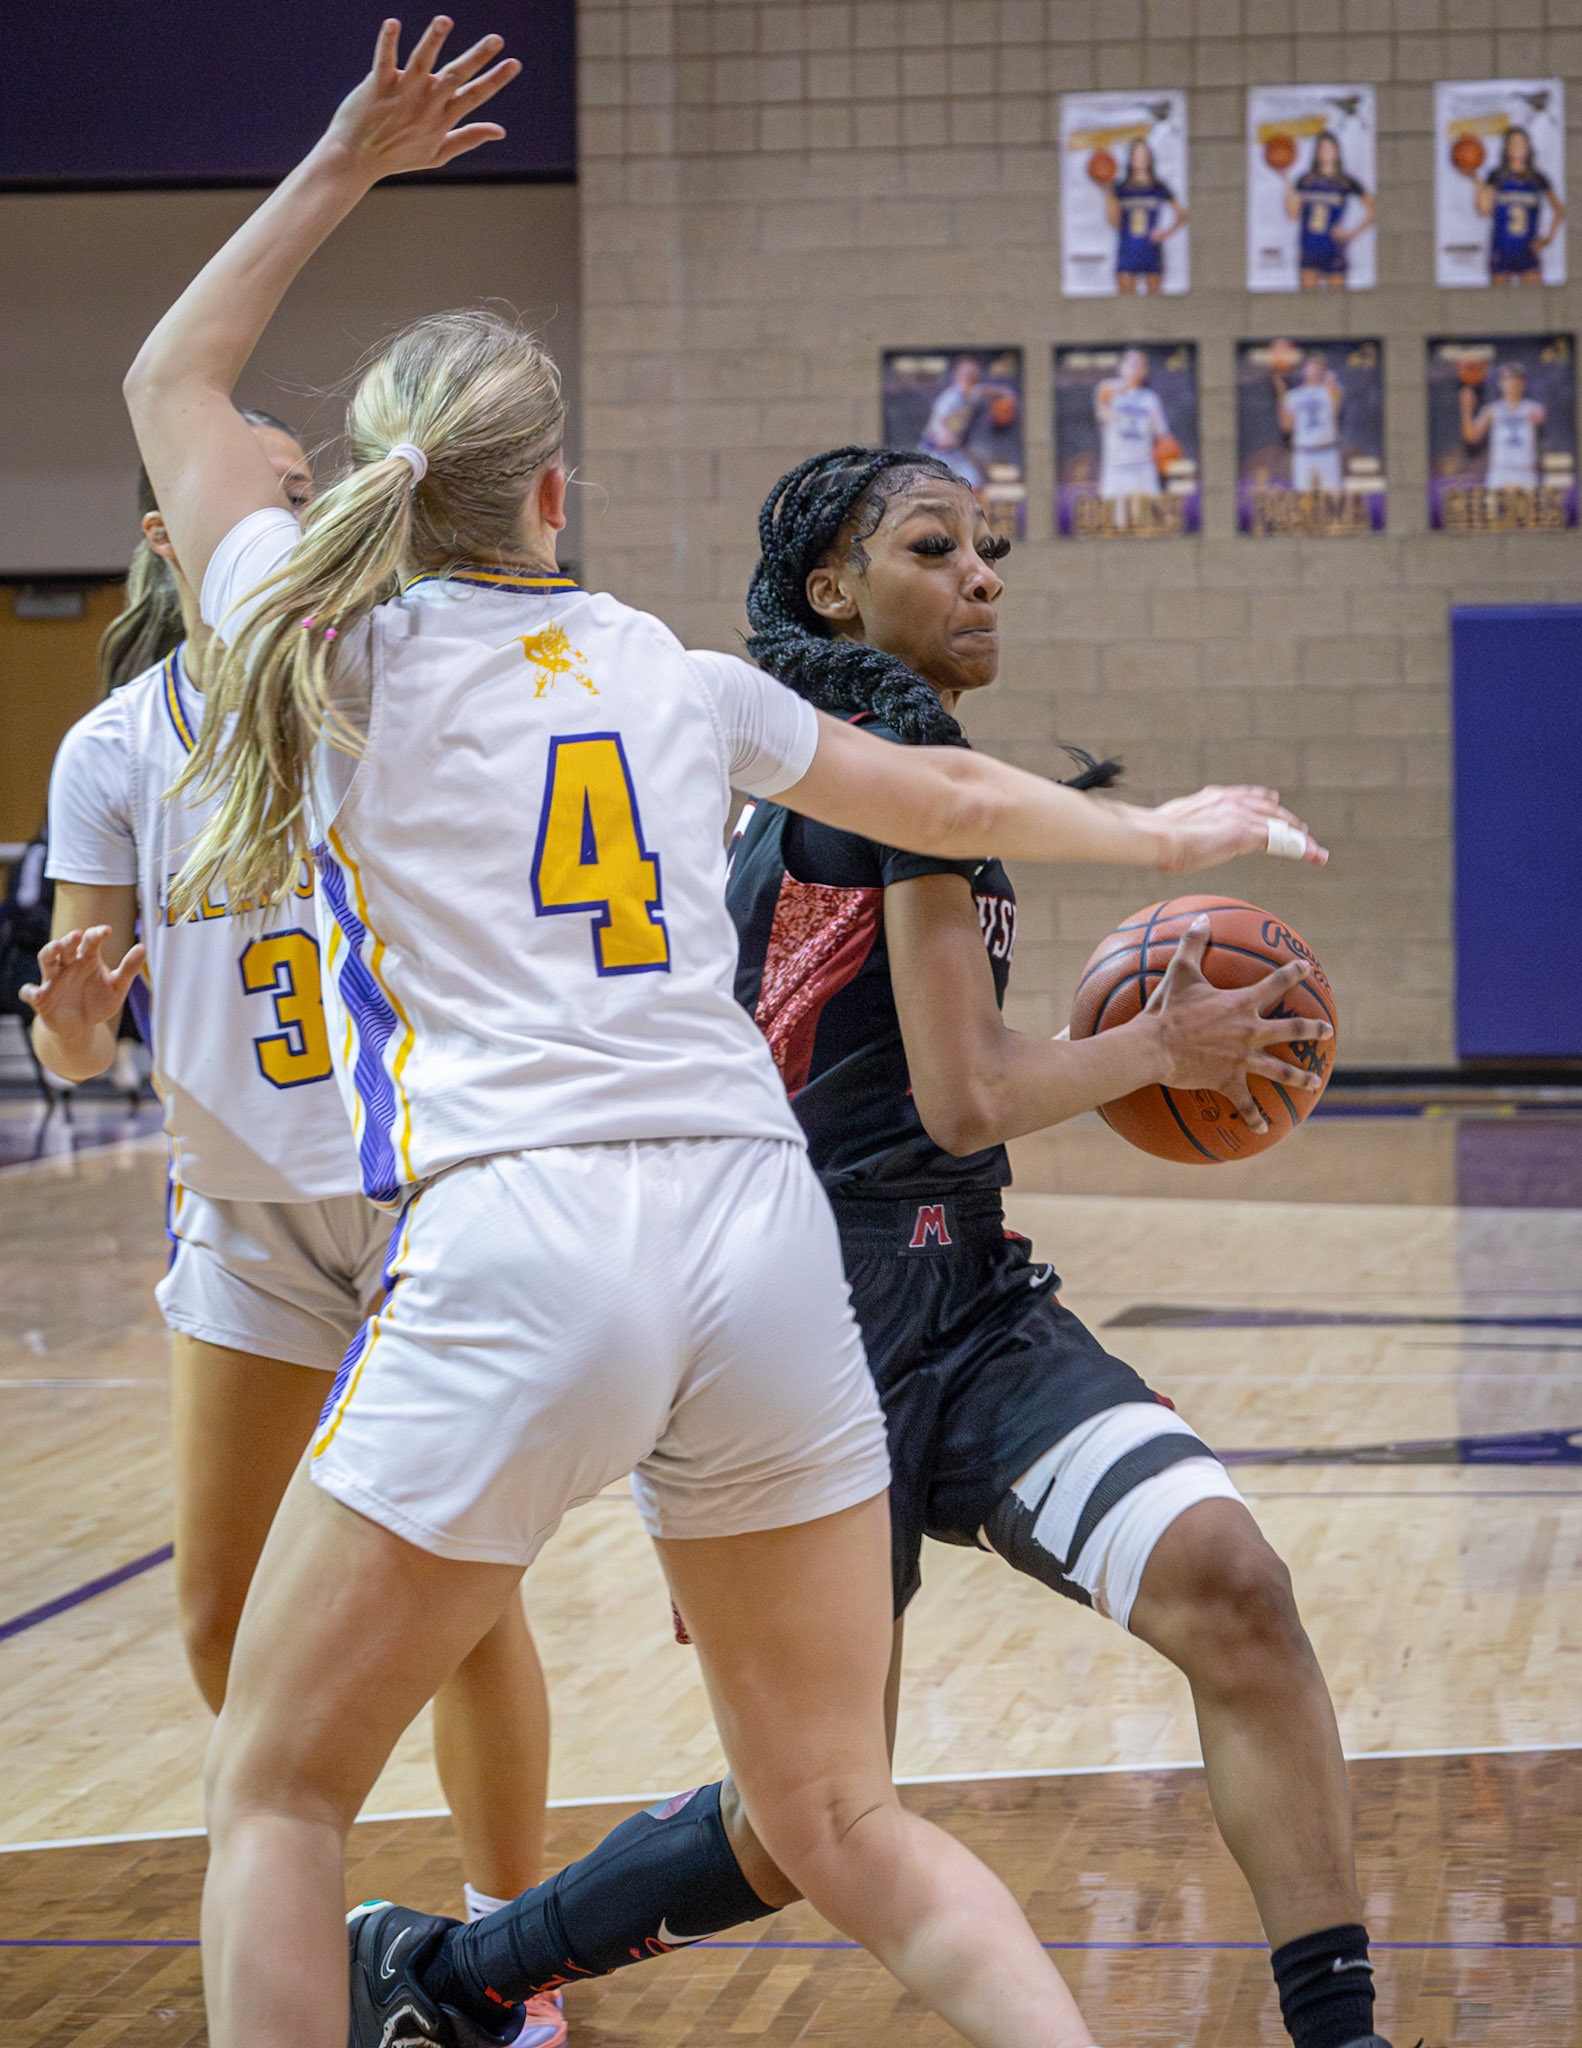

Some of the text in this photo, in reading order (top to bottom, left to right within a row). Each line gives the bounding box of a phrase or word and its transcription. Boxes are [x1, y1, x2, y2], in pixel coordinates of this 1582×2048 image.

[530, 731, 671, 978] 4
[238, 928, 335, 1090] 3
[909, 1204, 952, 1248] M
